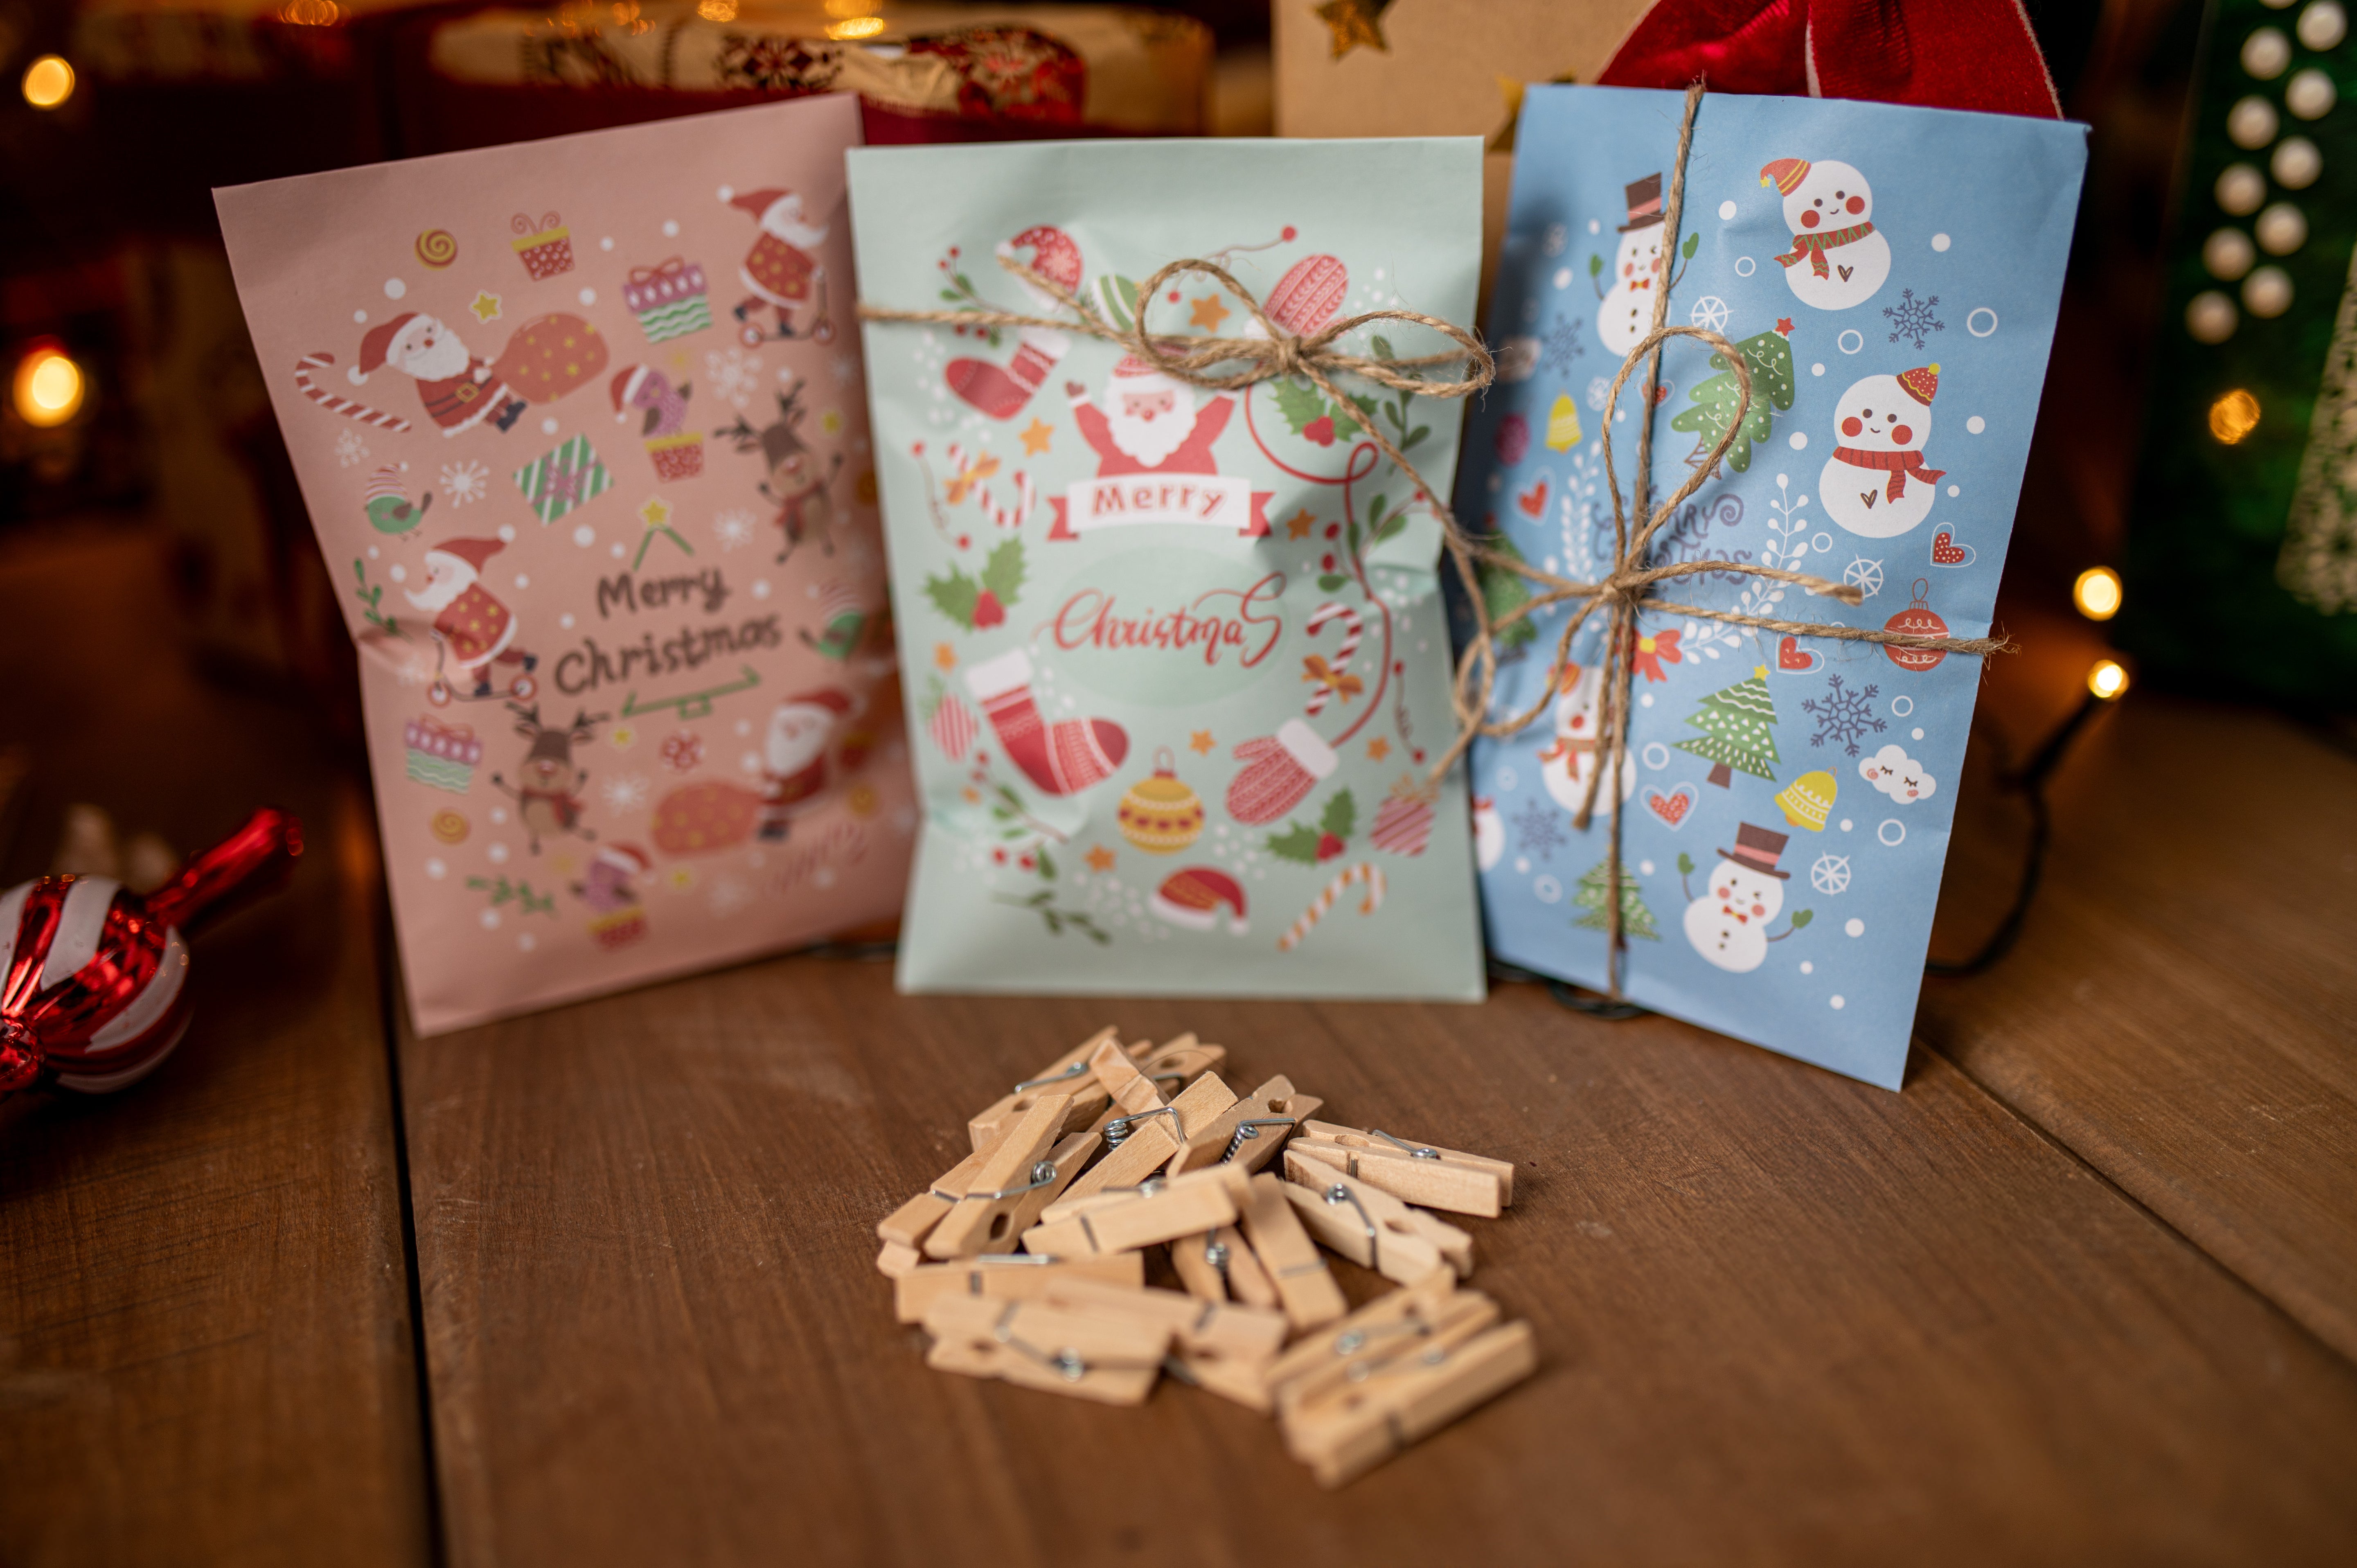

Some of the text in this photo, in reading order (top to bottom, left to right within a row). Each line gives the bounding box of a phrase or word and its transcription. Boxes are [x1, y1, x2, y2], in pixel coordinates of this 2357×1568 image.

[1092, 484, 1226, 518] Merry
[597, 569, 731, 618] Merry
[554, 613, 782, 696] Christmas
